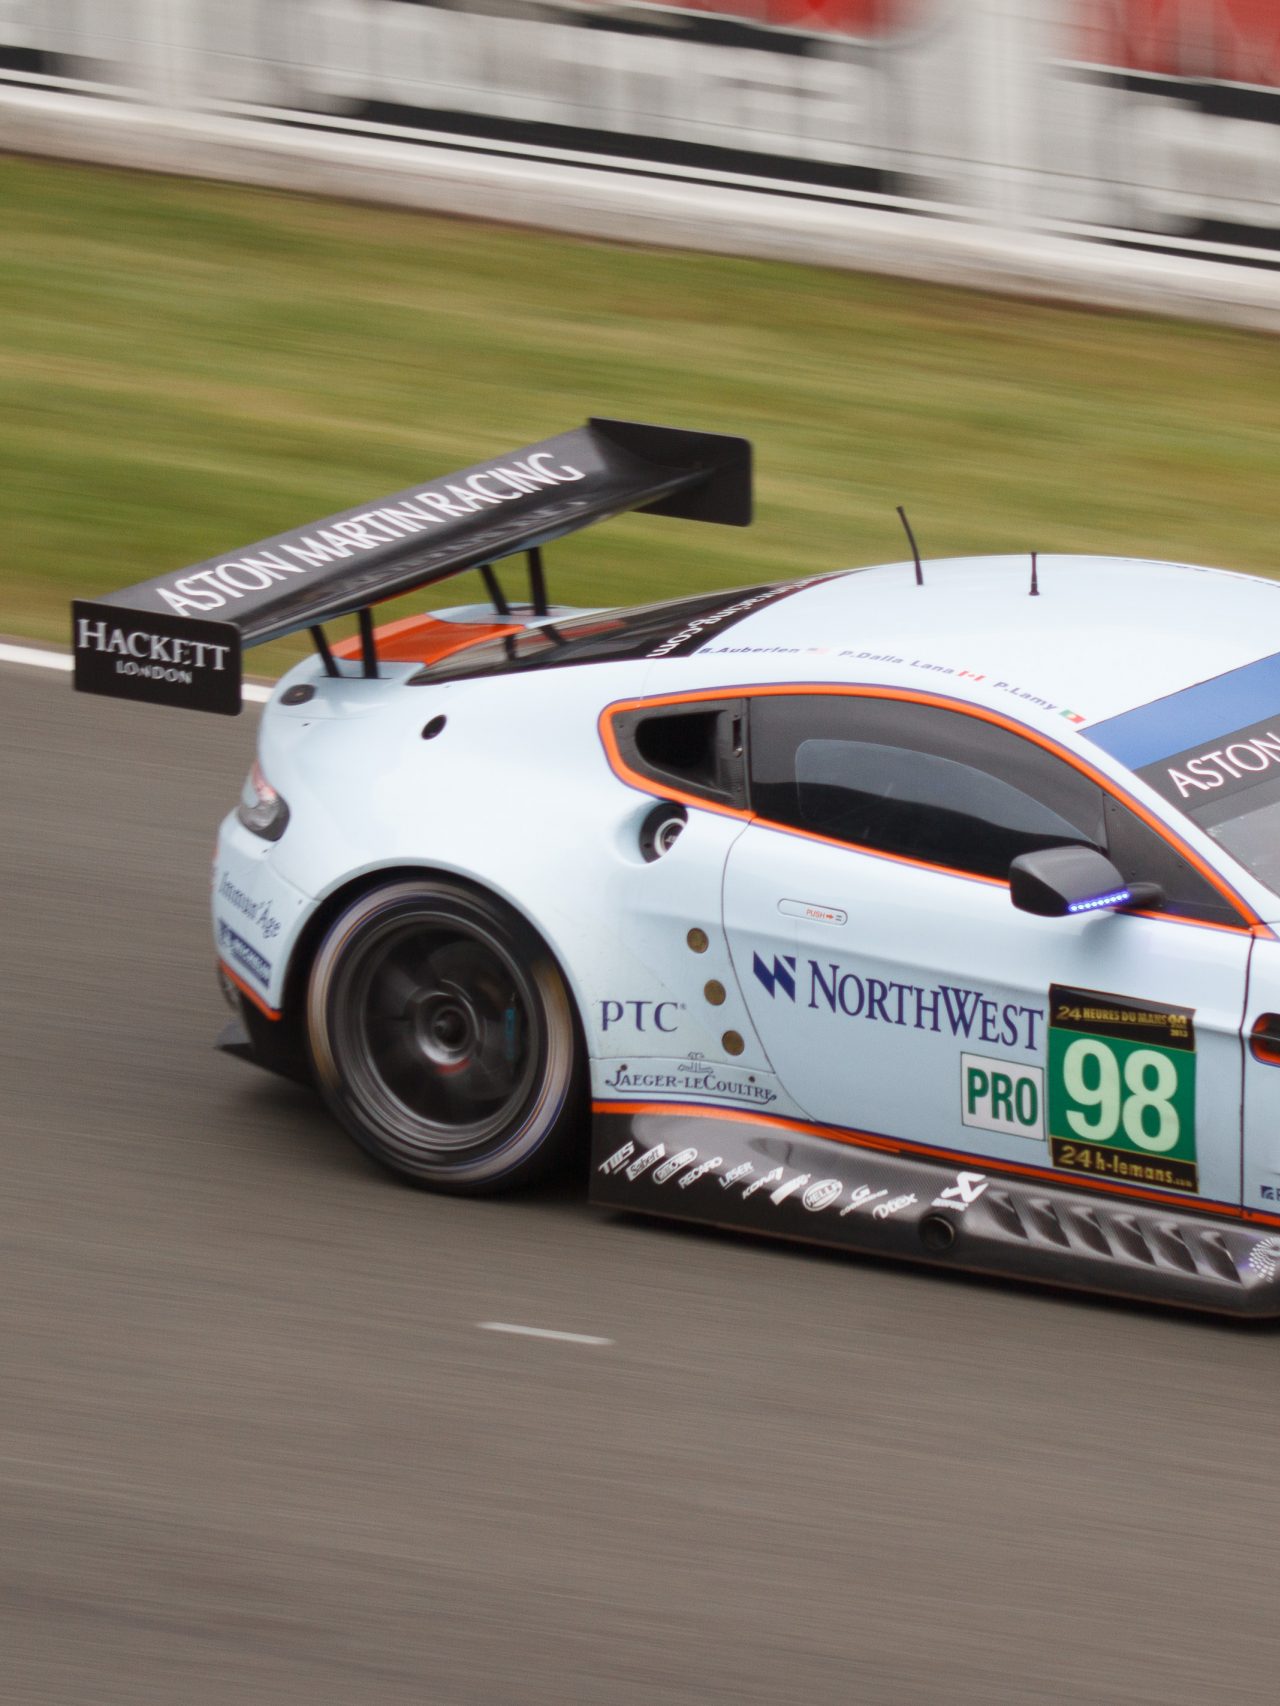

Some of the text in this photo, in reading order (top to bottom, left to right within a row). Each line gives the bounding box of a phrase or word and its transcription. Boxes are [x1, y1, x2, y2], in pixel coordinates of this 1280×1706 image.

[156, 551, 301, 616] ASTON
[300, 500, 444, 568] MARTIN
[414, 452, 587, 518] RACING
[77, 618, 230, 671] HACKETT
[115, 659, 193, 685] LONDON
[807, 959, 1044, 1051] NORTHWEST
[1056, 1005, 1081, 1022] 24
[1120, 1010, 1137, 1023] DU
[967, 1066, 1039, 1126] PRO
[1063, 1038, 1180, 1153] 98
